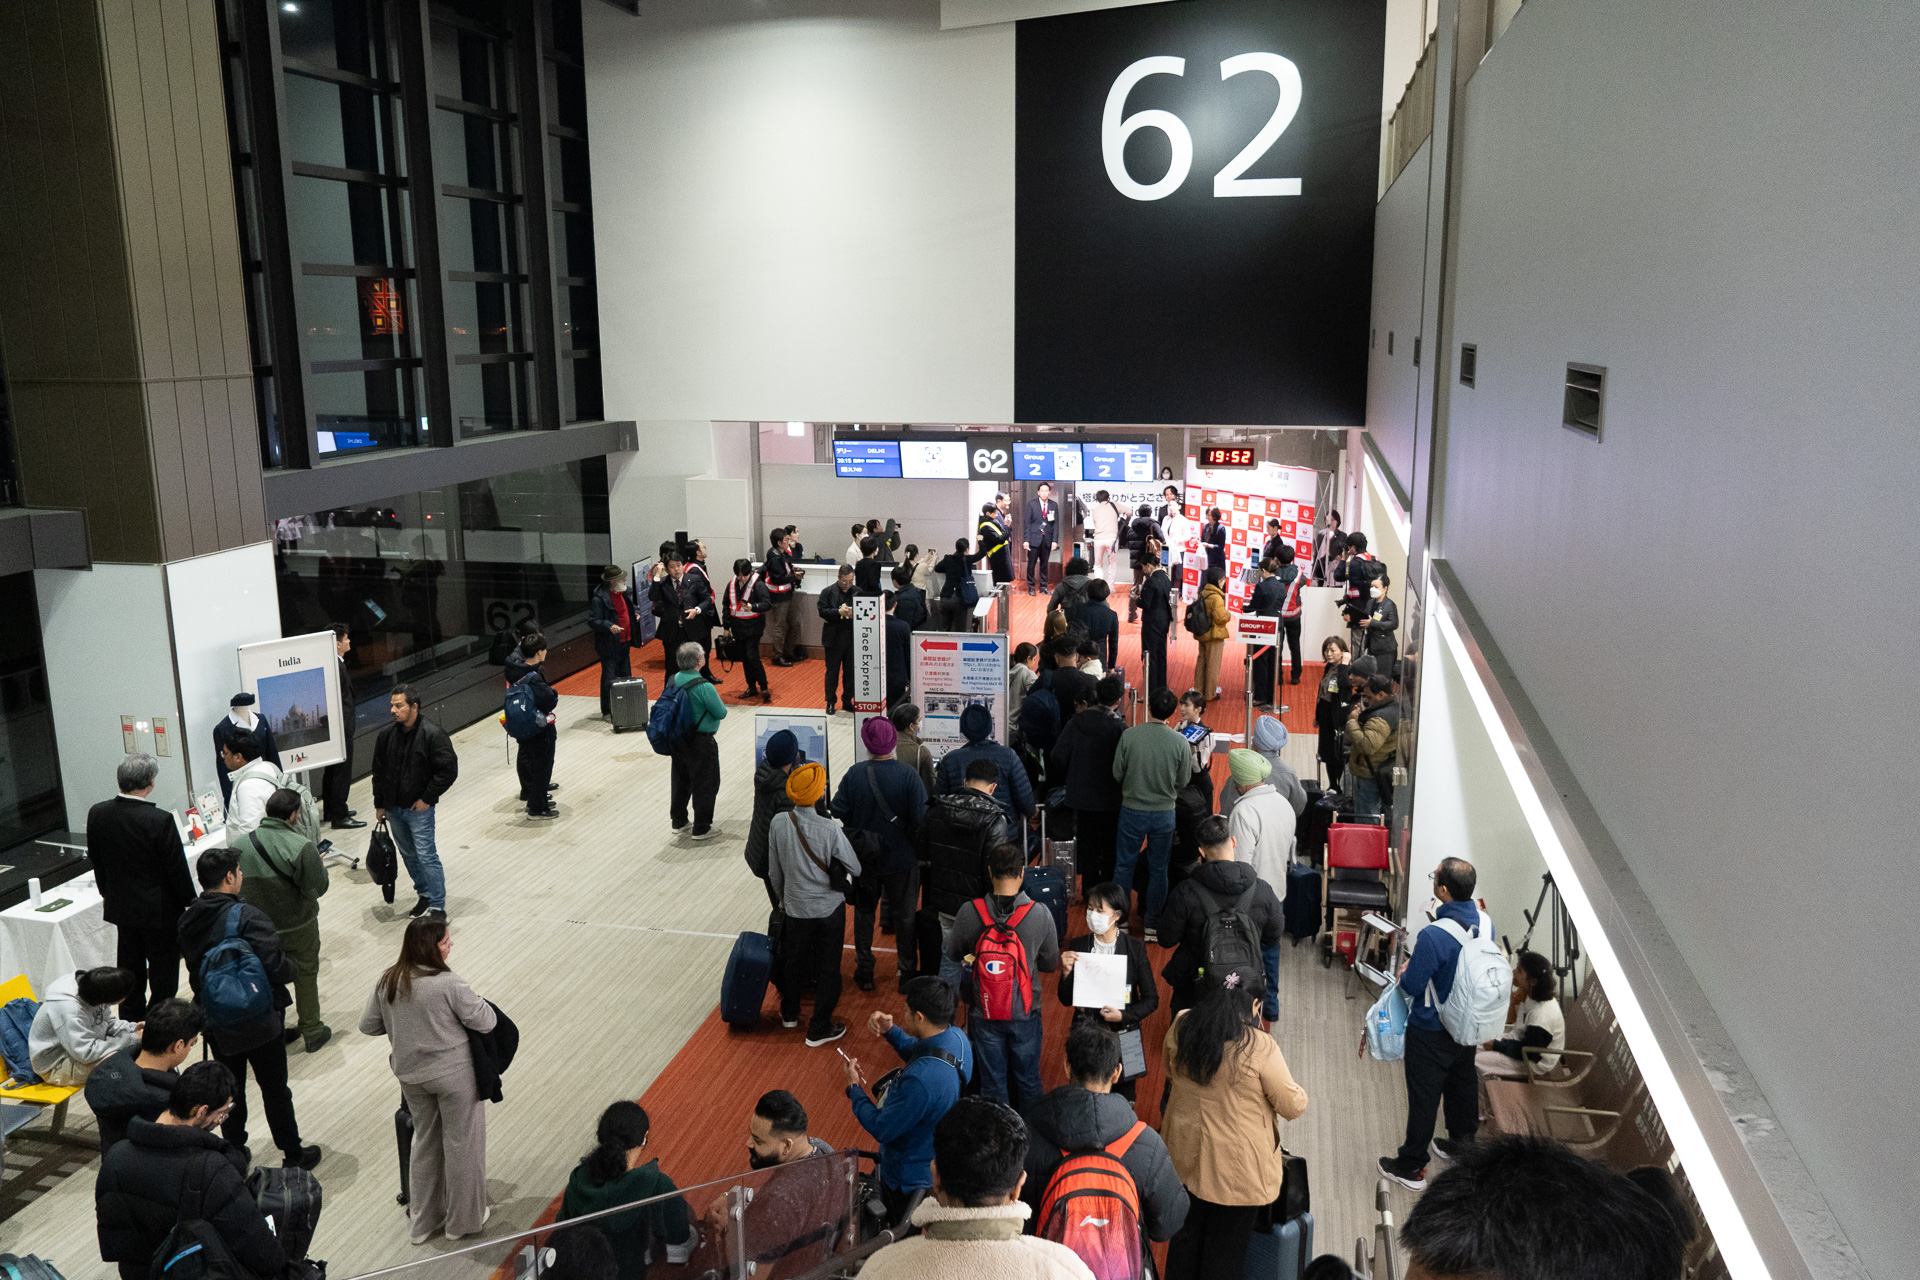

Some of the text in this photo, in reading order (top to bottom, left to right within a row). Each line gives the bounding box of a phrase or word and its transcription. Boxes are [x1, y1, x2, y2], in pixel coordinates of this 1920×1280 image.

[1102, 52, 1303, 201] 62
[973, 448, 1009, 474] 62
[1023, 453, 1045, 461] Group
[1209, 450, 1252, 464] 19:52
[1028, 463, 1042, 476] 2
[1098, 465, 1111, 478] 2
[278, 656, 302, 668] India
[860, 626, 873, 697] Face Express
[858, 703, 878, 711] STOP
[290, 752, 307, 764] JAL
